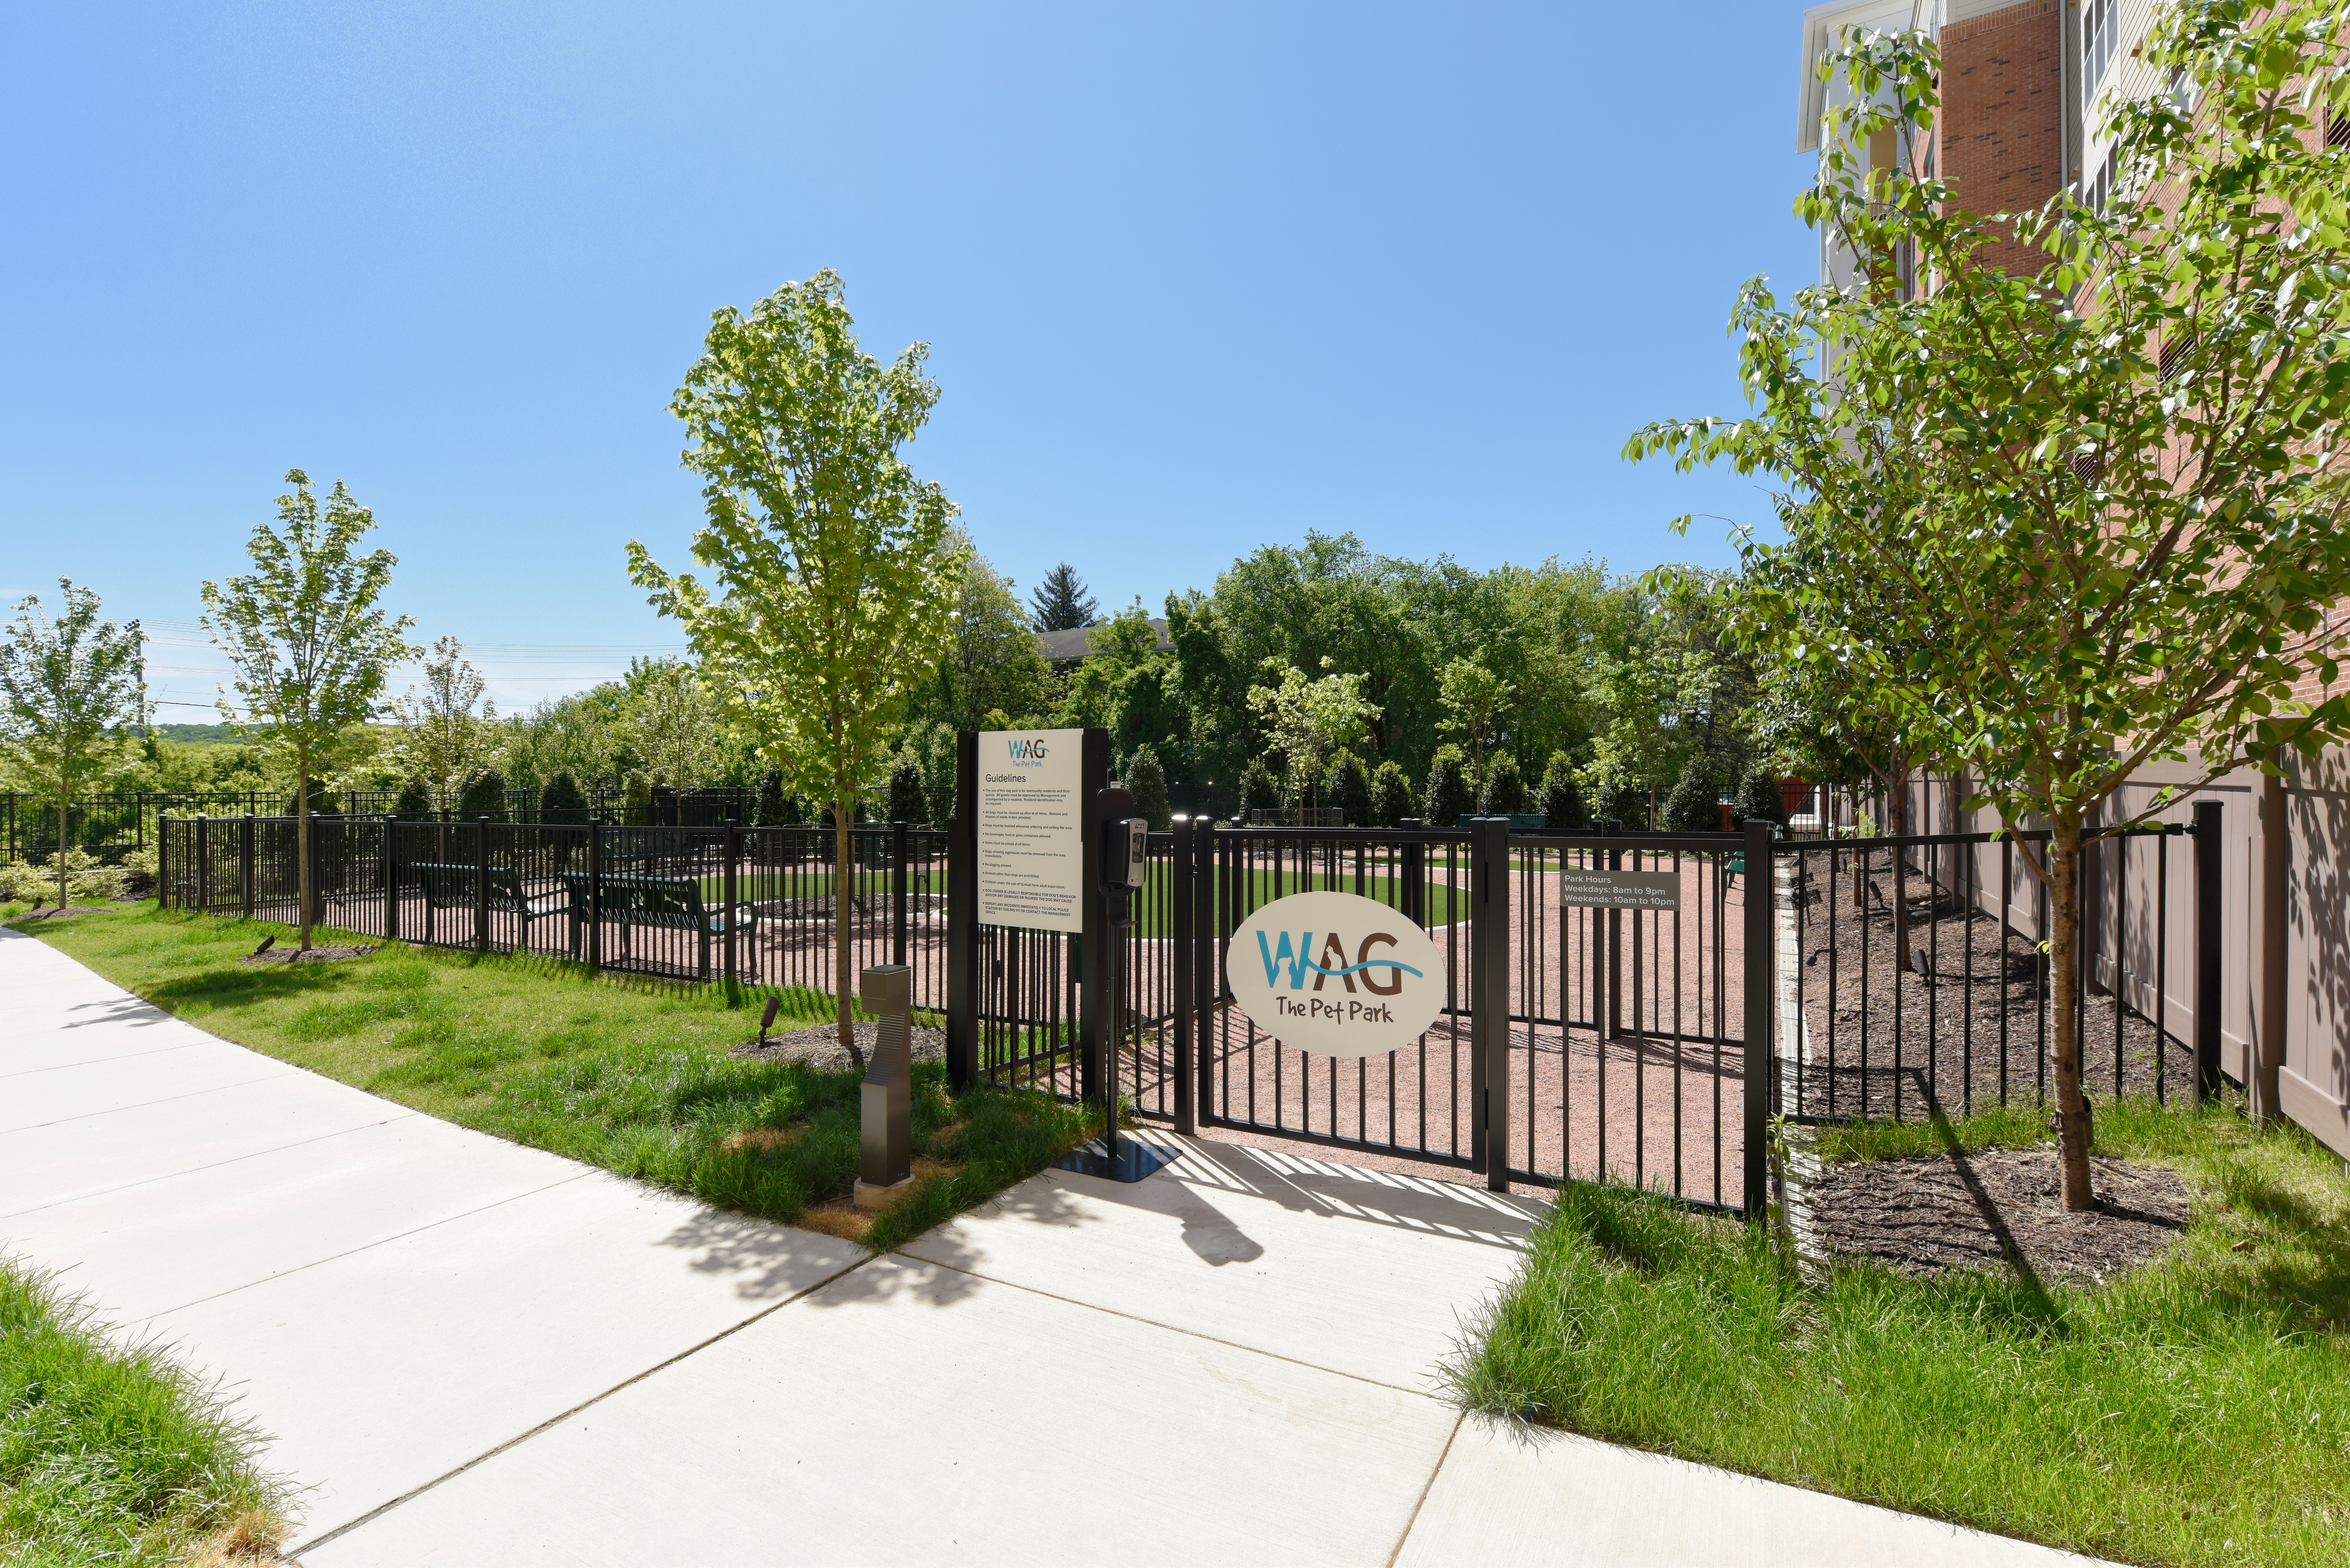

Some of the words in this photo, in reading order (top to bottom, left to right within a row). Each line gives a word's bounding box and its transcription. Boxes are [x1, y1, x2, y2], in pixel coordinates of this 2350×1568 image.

[1008, 739, 1050, 758] WAG
[1565, 885, 1610, 894] Weekdays:
[1645, 888, 1665, 896] 9pm
[1256, 930, 1423, 996] WAG
[1276, 996, 1306, 1015] The
[1310, 999, 1344, 1024] Pet
[1349, 1001, 1394, 1023] Park
